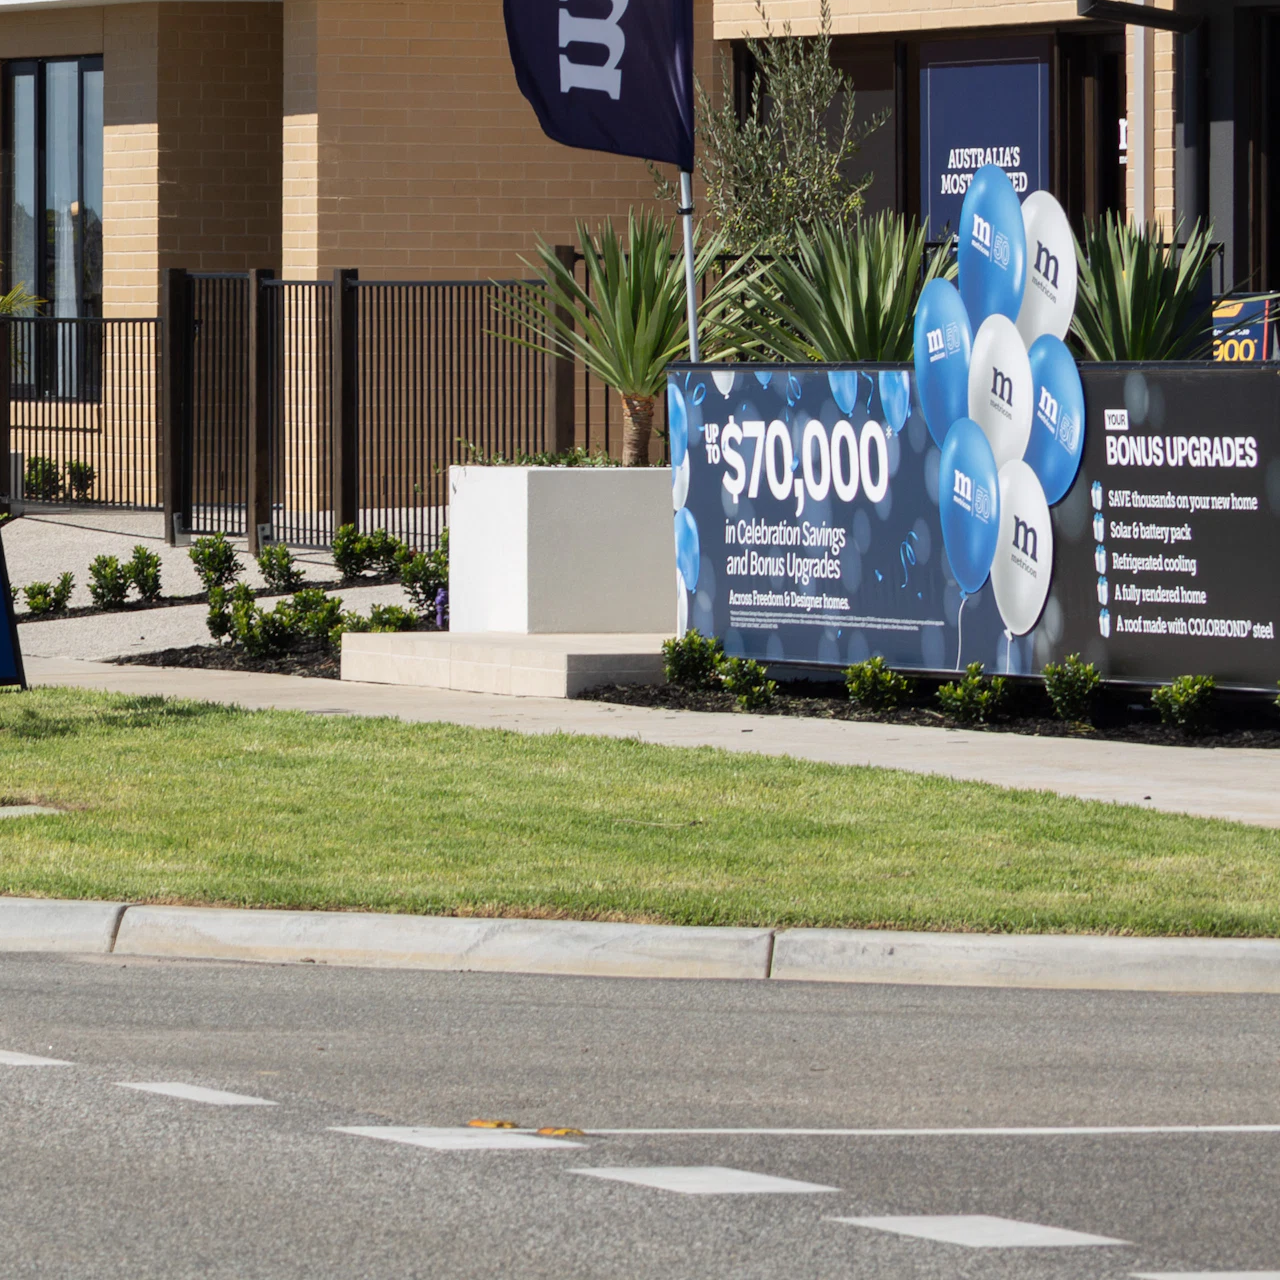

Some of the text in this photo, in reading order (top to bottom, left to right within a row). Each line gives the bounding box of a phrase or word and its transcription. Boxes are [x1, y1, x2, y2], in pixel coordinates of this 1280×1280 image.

[948, 146, 1020, 169] AUSTRALIA'S
[972, 214, 991, 247] m
[1034, 240, 1059, 290] m
[1032, 276, 1057, 304] metricon
[926, 328, 944, 353] m
[991, 367, 1013, 407] m
[1038, 386, 1057, 424] m
[1107, 414, 1126, 426] YOUR
[705, 423, 719, 444] UP
[706, 443, 720, 464] TO
[1106, 436, 1258, 467] BONUS UPGRADES
[954, 469, 972, 502] m
[1108, 490, 1258, 513] SAVE thousands on your new home
[725, 518, 846, 556] in Celebration Savings
[1012, 515, 1037, 563] m
[1110, 521, 1132, 538] Solar
[1139, 522, 1170, 544] battery
[1170, 523, 1192, 544] pack
[726, 549, 841, 586] and Bonus Upgrades
[1112, 553, 1197, 577] Refrigerated cooling
[729, 589, 752, 606] Across
[752, 590, 784, 607] Freedom
[790, 591, 822, 612] Designer
[1114, 584, 1207, 605] A fully rendered home
[1116, 615, 1124, 632] A
[1124, 615, 1143, 633] roof
[1143, 616, 1168, 634] made
[1167, 617, 1188, 635] with
[1252, 621, 1274, 639] steel
